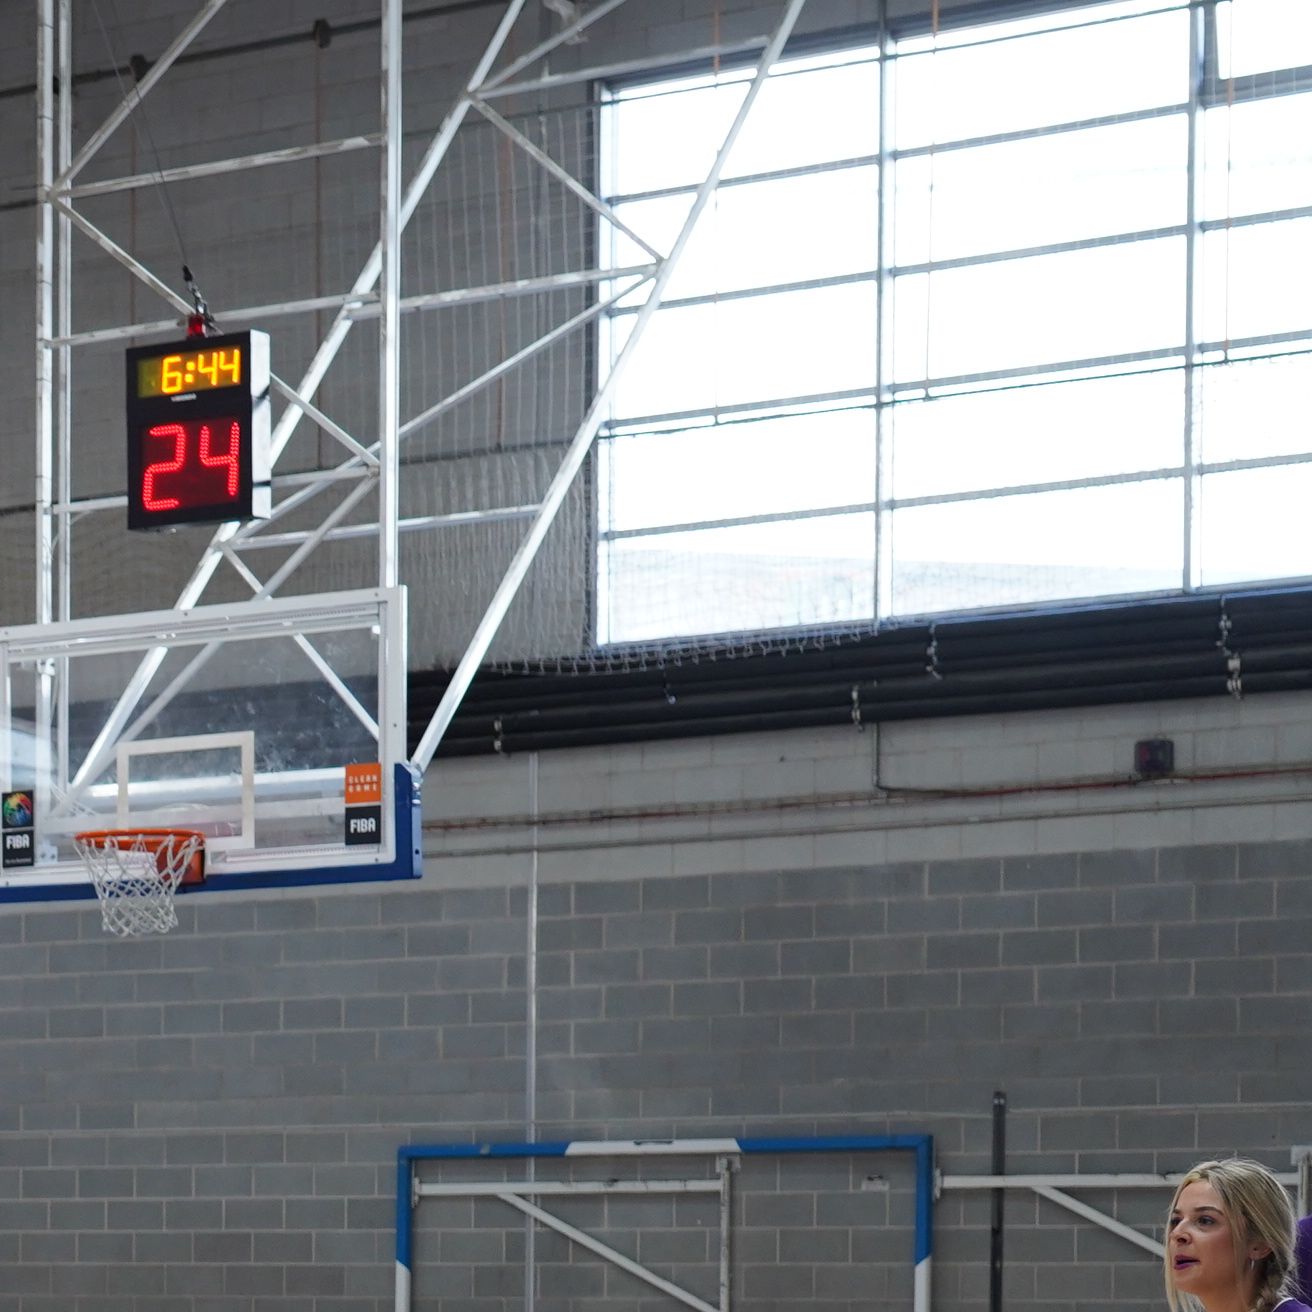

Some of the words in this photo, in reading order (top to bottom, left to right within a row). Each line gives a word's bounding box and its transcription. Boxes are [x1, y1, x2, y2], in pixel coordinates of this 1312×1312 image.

[161, 348, 241, 394] 6:44
[143, 421, 241, 511] 24
[349, 817, 376, 834] FIBA
[6, 834, 30, 849] FIBA
